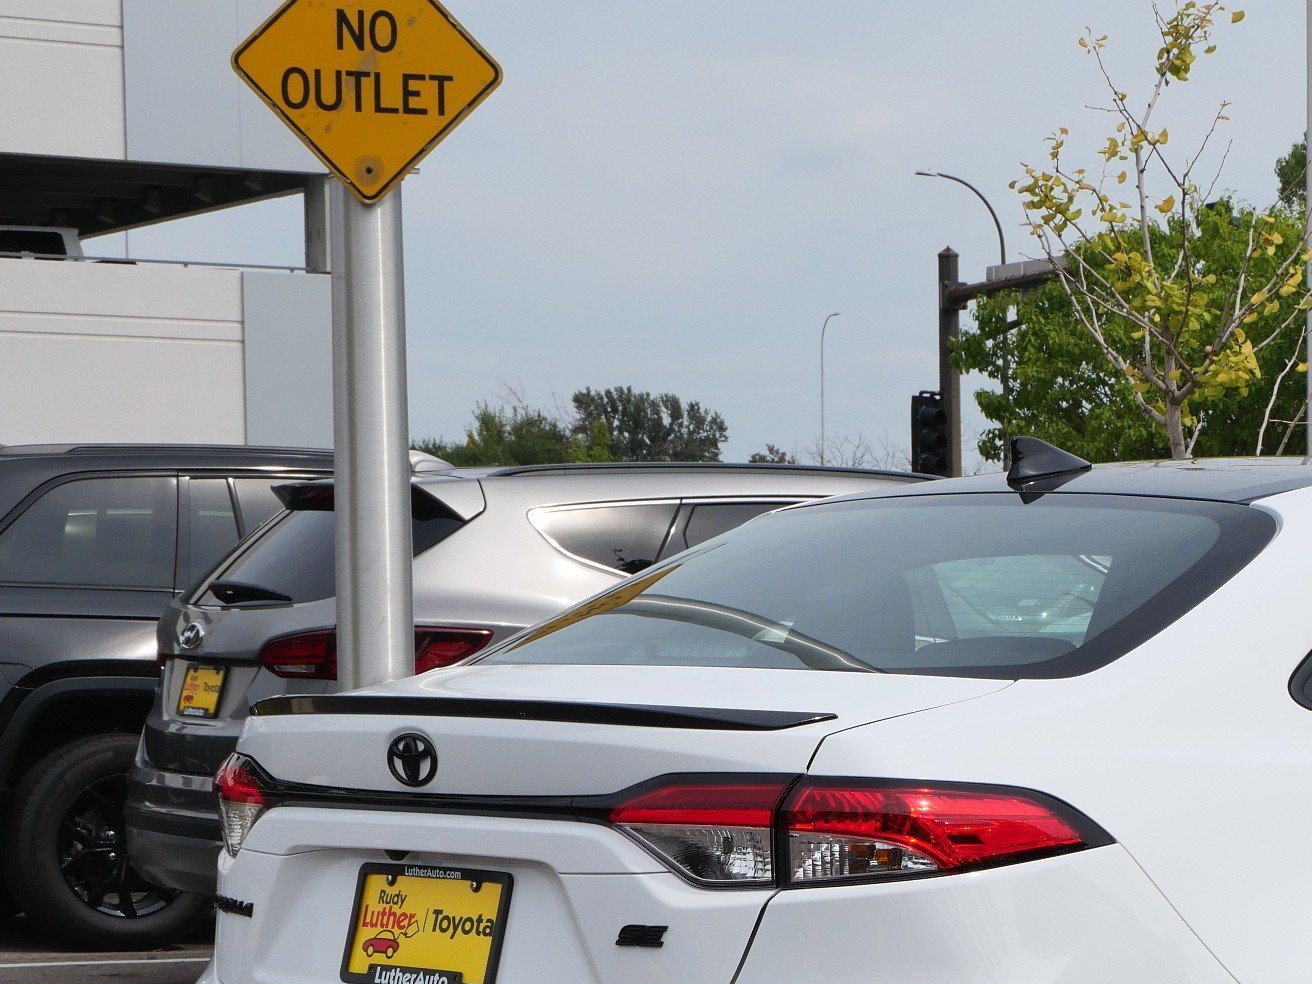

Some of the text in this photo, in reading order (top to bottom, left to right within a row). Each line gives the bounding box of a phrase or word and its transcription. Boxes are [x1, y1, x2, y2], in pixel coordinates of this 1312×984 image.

[336, 8, 398, 53] NO
[281, 66, 454, 116] OUTLET
[405, 866, 462, 880] LutherAuto.com
[378, 889, 408, 909] Rudy
[361, 904, 416, 930] Luther
[432, 909, 496, 939] Toyota
